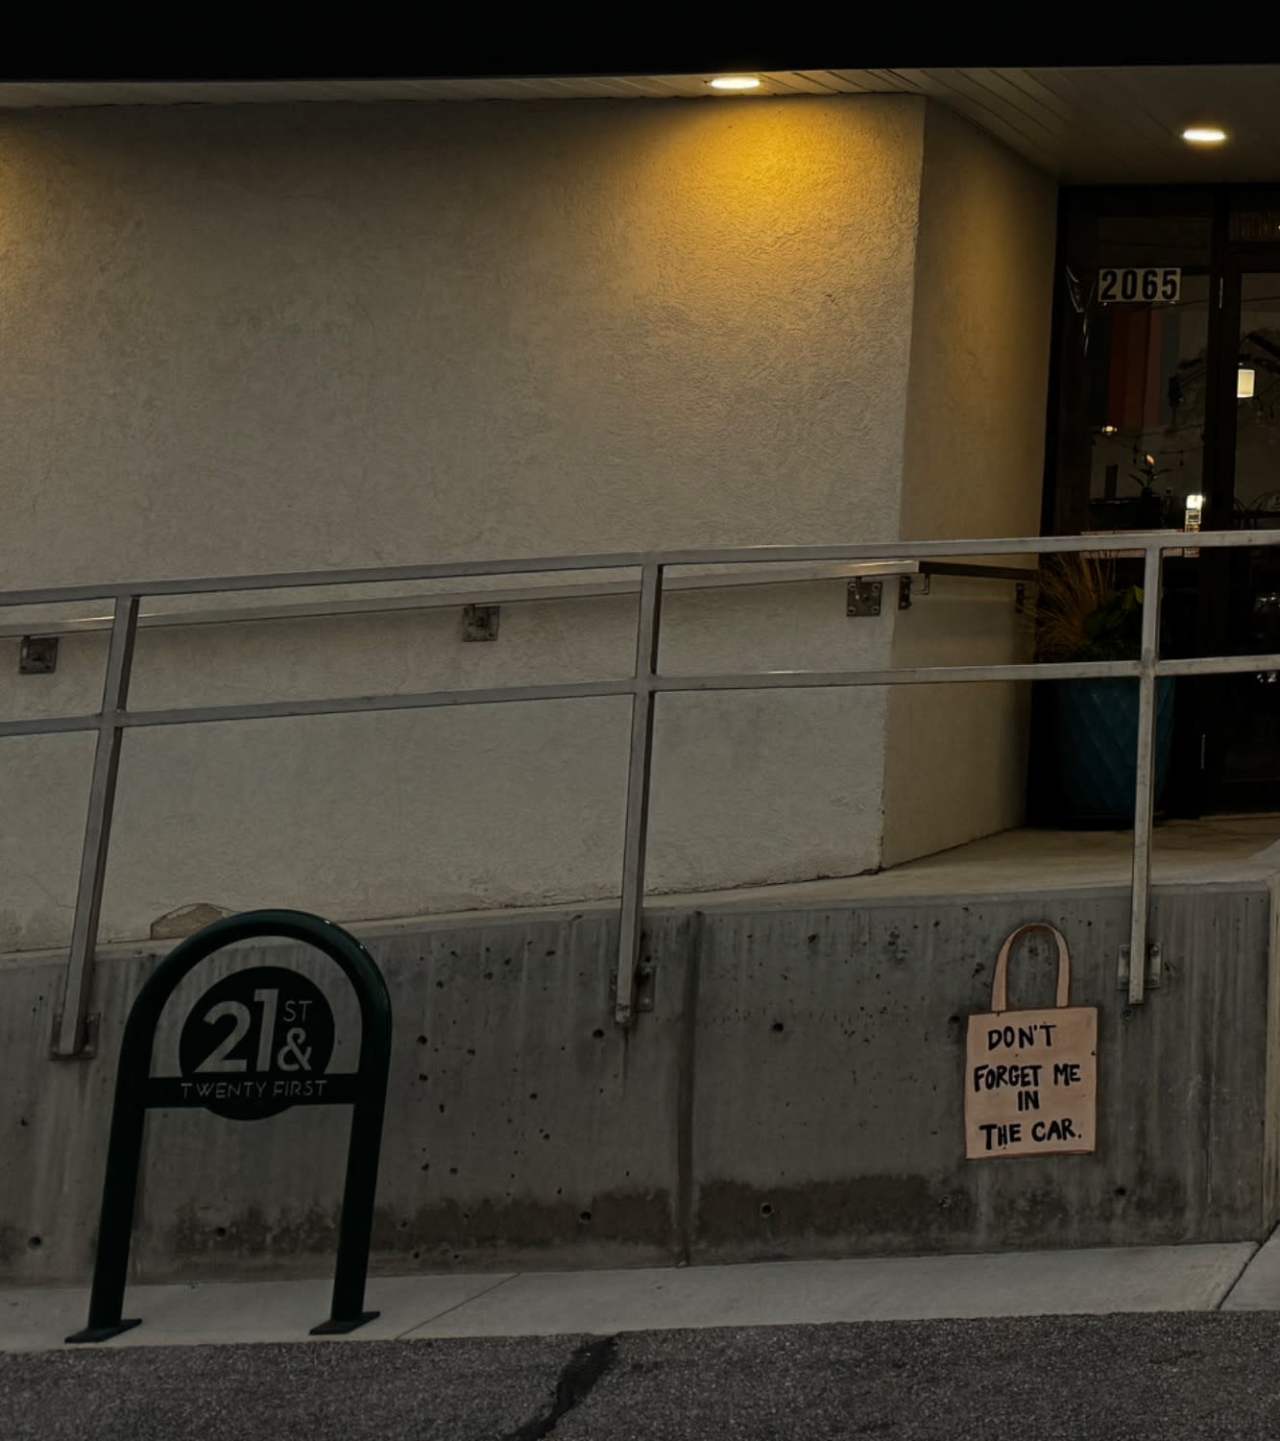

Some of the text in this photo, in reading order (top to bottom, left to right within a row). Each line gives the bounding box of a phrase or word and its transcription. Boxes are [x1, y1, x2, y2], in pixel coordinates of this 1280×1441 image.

[1101, 270, 1178, 300] 2065
[988, 1025, 1056, 1050] DON'T
[974, 1063, 1081, 1091] FORGET ME
[1017, 1090, 1040, 1111] IN
[980, 1123, 1022, 1150] THE
